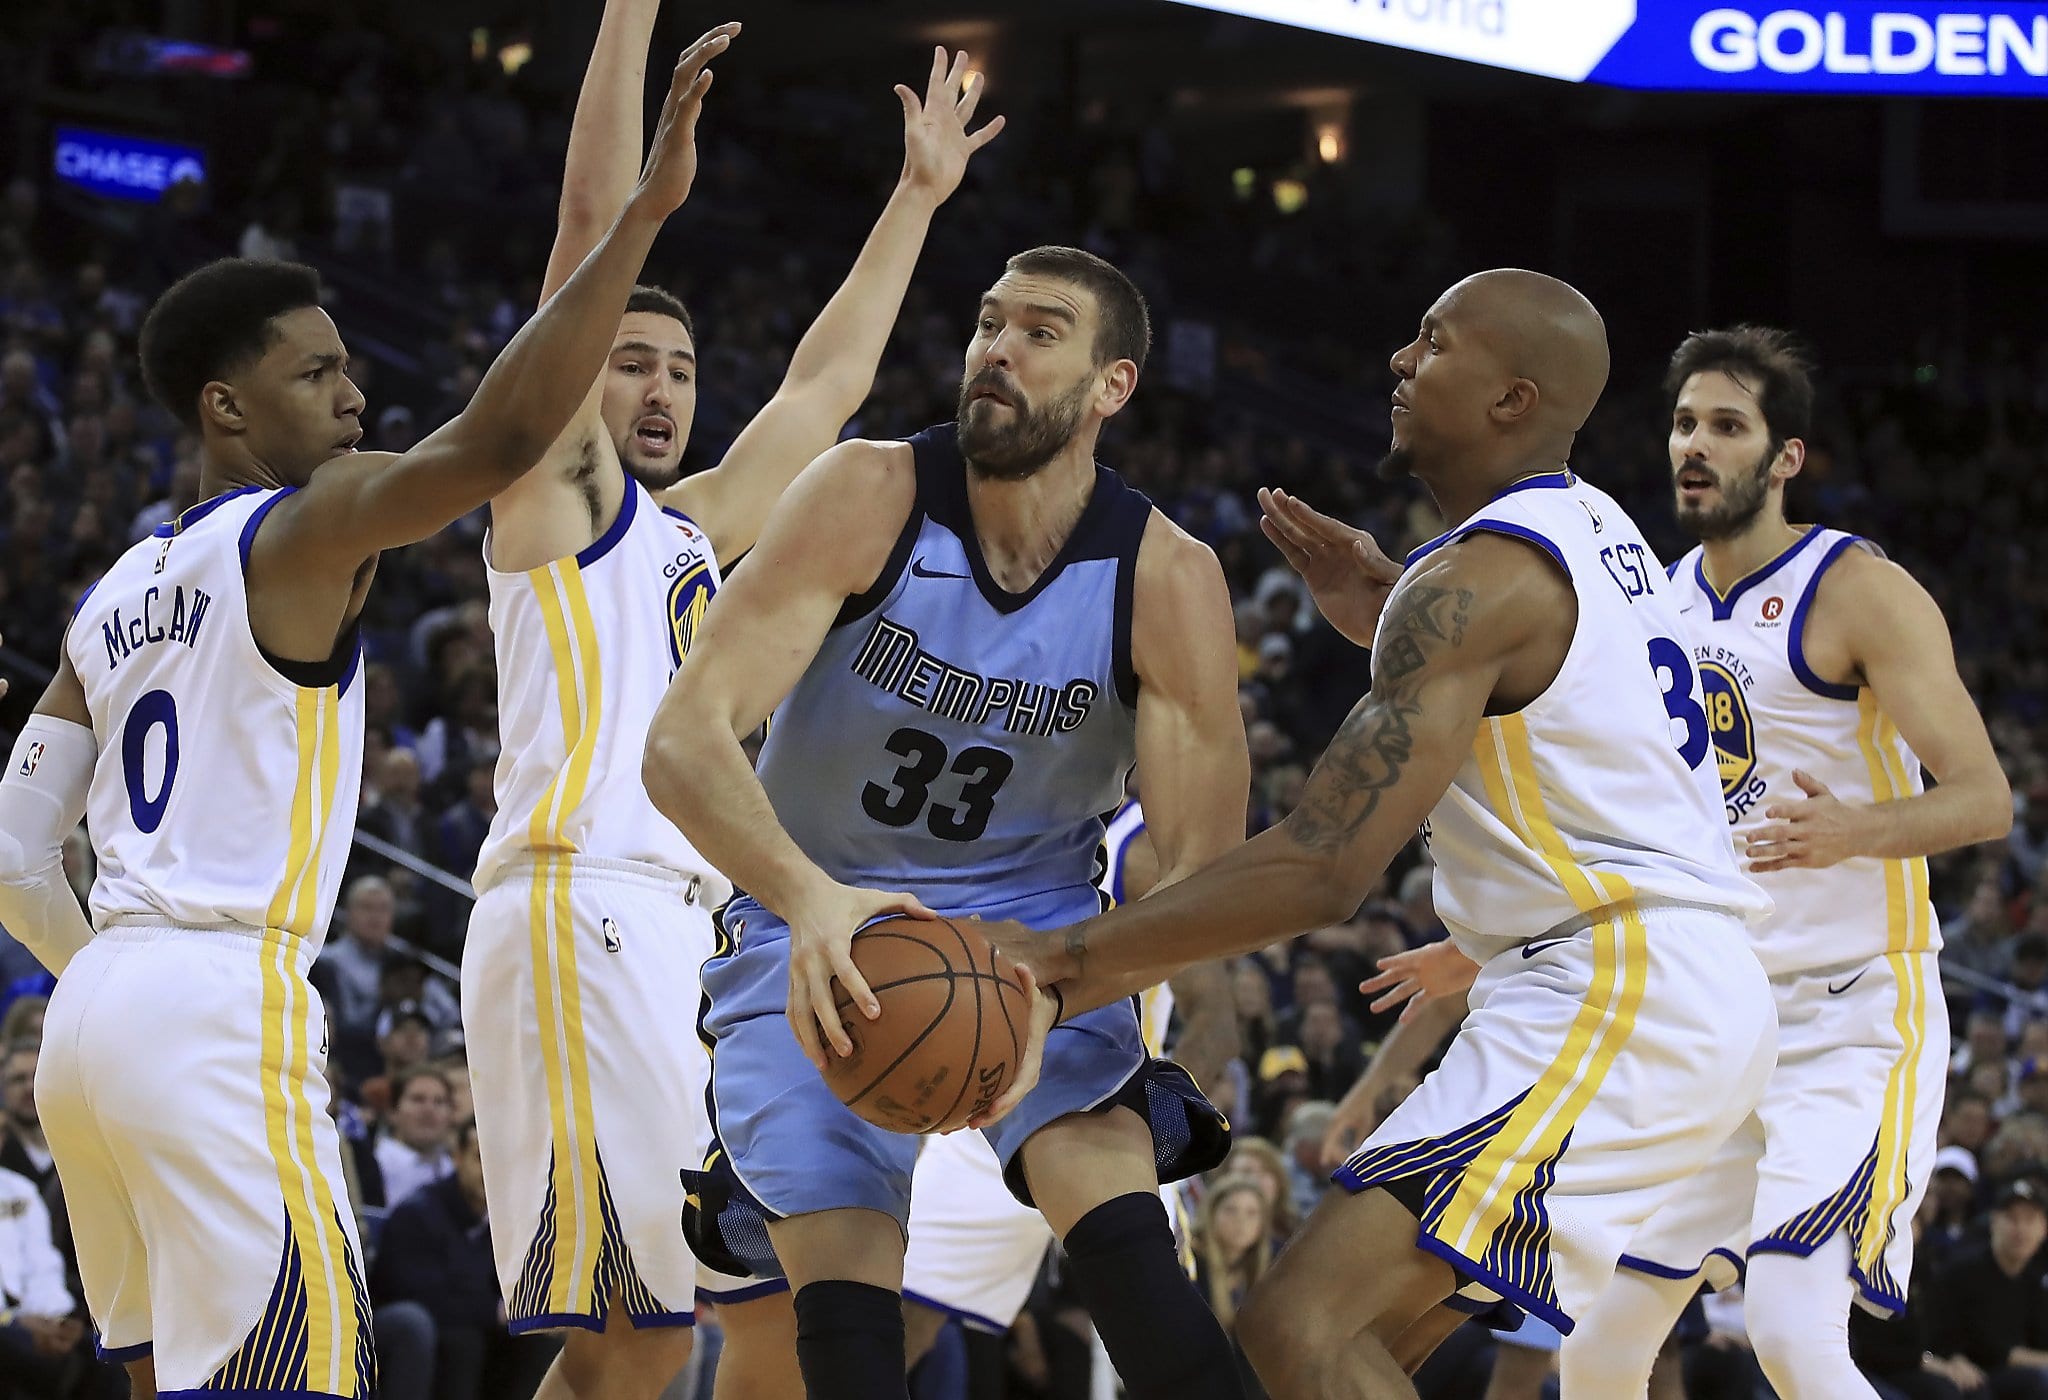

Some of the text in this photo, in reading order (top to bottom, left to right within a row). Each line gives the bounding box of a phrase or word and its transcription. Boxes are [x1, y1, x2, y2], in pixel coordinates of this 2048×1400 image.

[1350, 0, 1506, 36] orld
[1690, 9, 2048, 76] GOLDEN
[101, 585, 211, 671] McCAW
[1716, 647, 1754, 691] STATE
[1705, 692, 1734, 732] 18
[122, 689, 180, 834] 0
[861, 727, 1014, 842] 33
